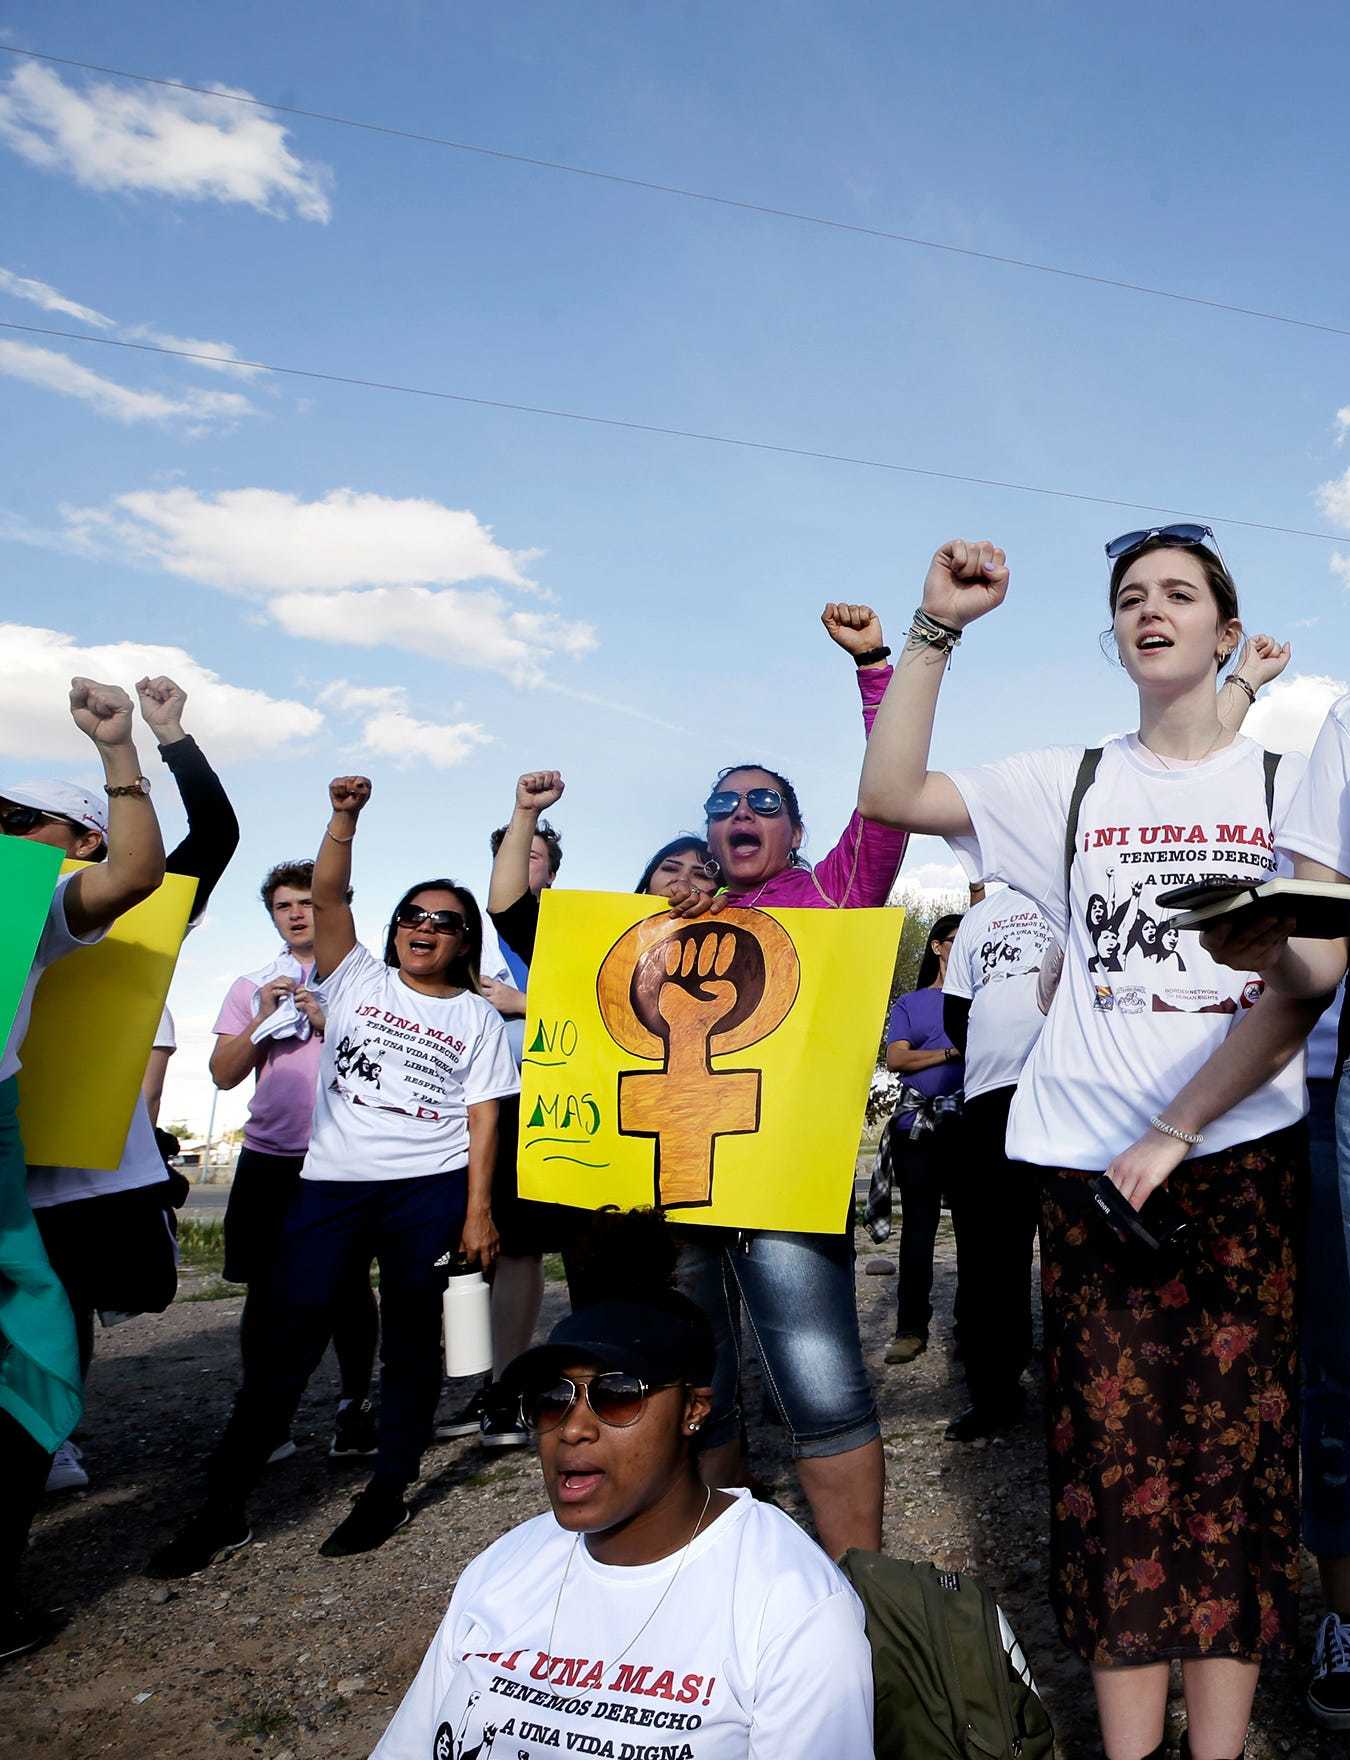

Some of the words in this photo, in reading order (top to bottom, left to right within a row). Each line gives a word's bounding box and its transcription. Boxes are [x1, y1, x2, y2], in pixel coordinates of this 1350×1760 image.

[1084, 827, 1130, 852] ¡NI
[1138, 824, 1209, 845] UNA
[1120, 850, 1207, 864] TENEMOS
[1144, 874, 1157, 885] A
[1160, 873, 1199, 886] UNA
[1010, 912, 1039, 923] UNA
[366, 1020, 417, 1042] TENEMOS
[418, 1037, 460, 1064] DERECHO
[382, 1040, 404, 1052] UNA
[406, 1046, 429, 1060] VIDA
[383, 1012, 421, 1034] UNA
[424, 1026, 467, 1055] MAS!
[528, 1018, 578, 1056] NO
[526, 1093, 601, 1135] MAS
[529, 1651, 603, 1690] UNA
[609, 1663, 717, 1706] MAS!
[489, 1675, 591, 1717] TENEMOS
[592, 1699, 702, 1731] DERECHO
[500, 1718, 516, 1737] A
[519, 1721, 562, 1748] UNA
[565, 1732, 619, 1760] VIDA
